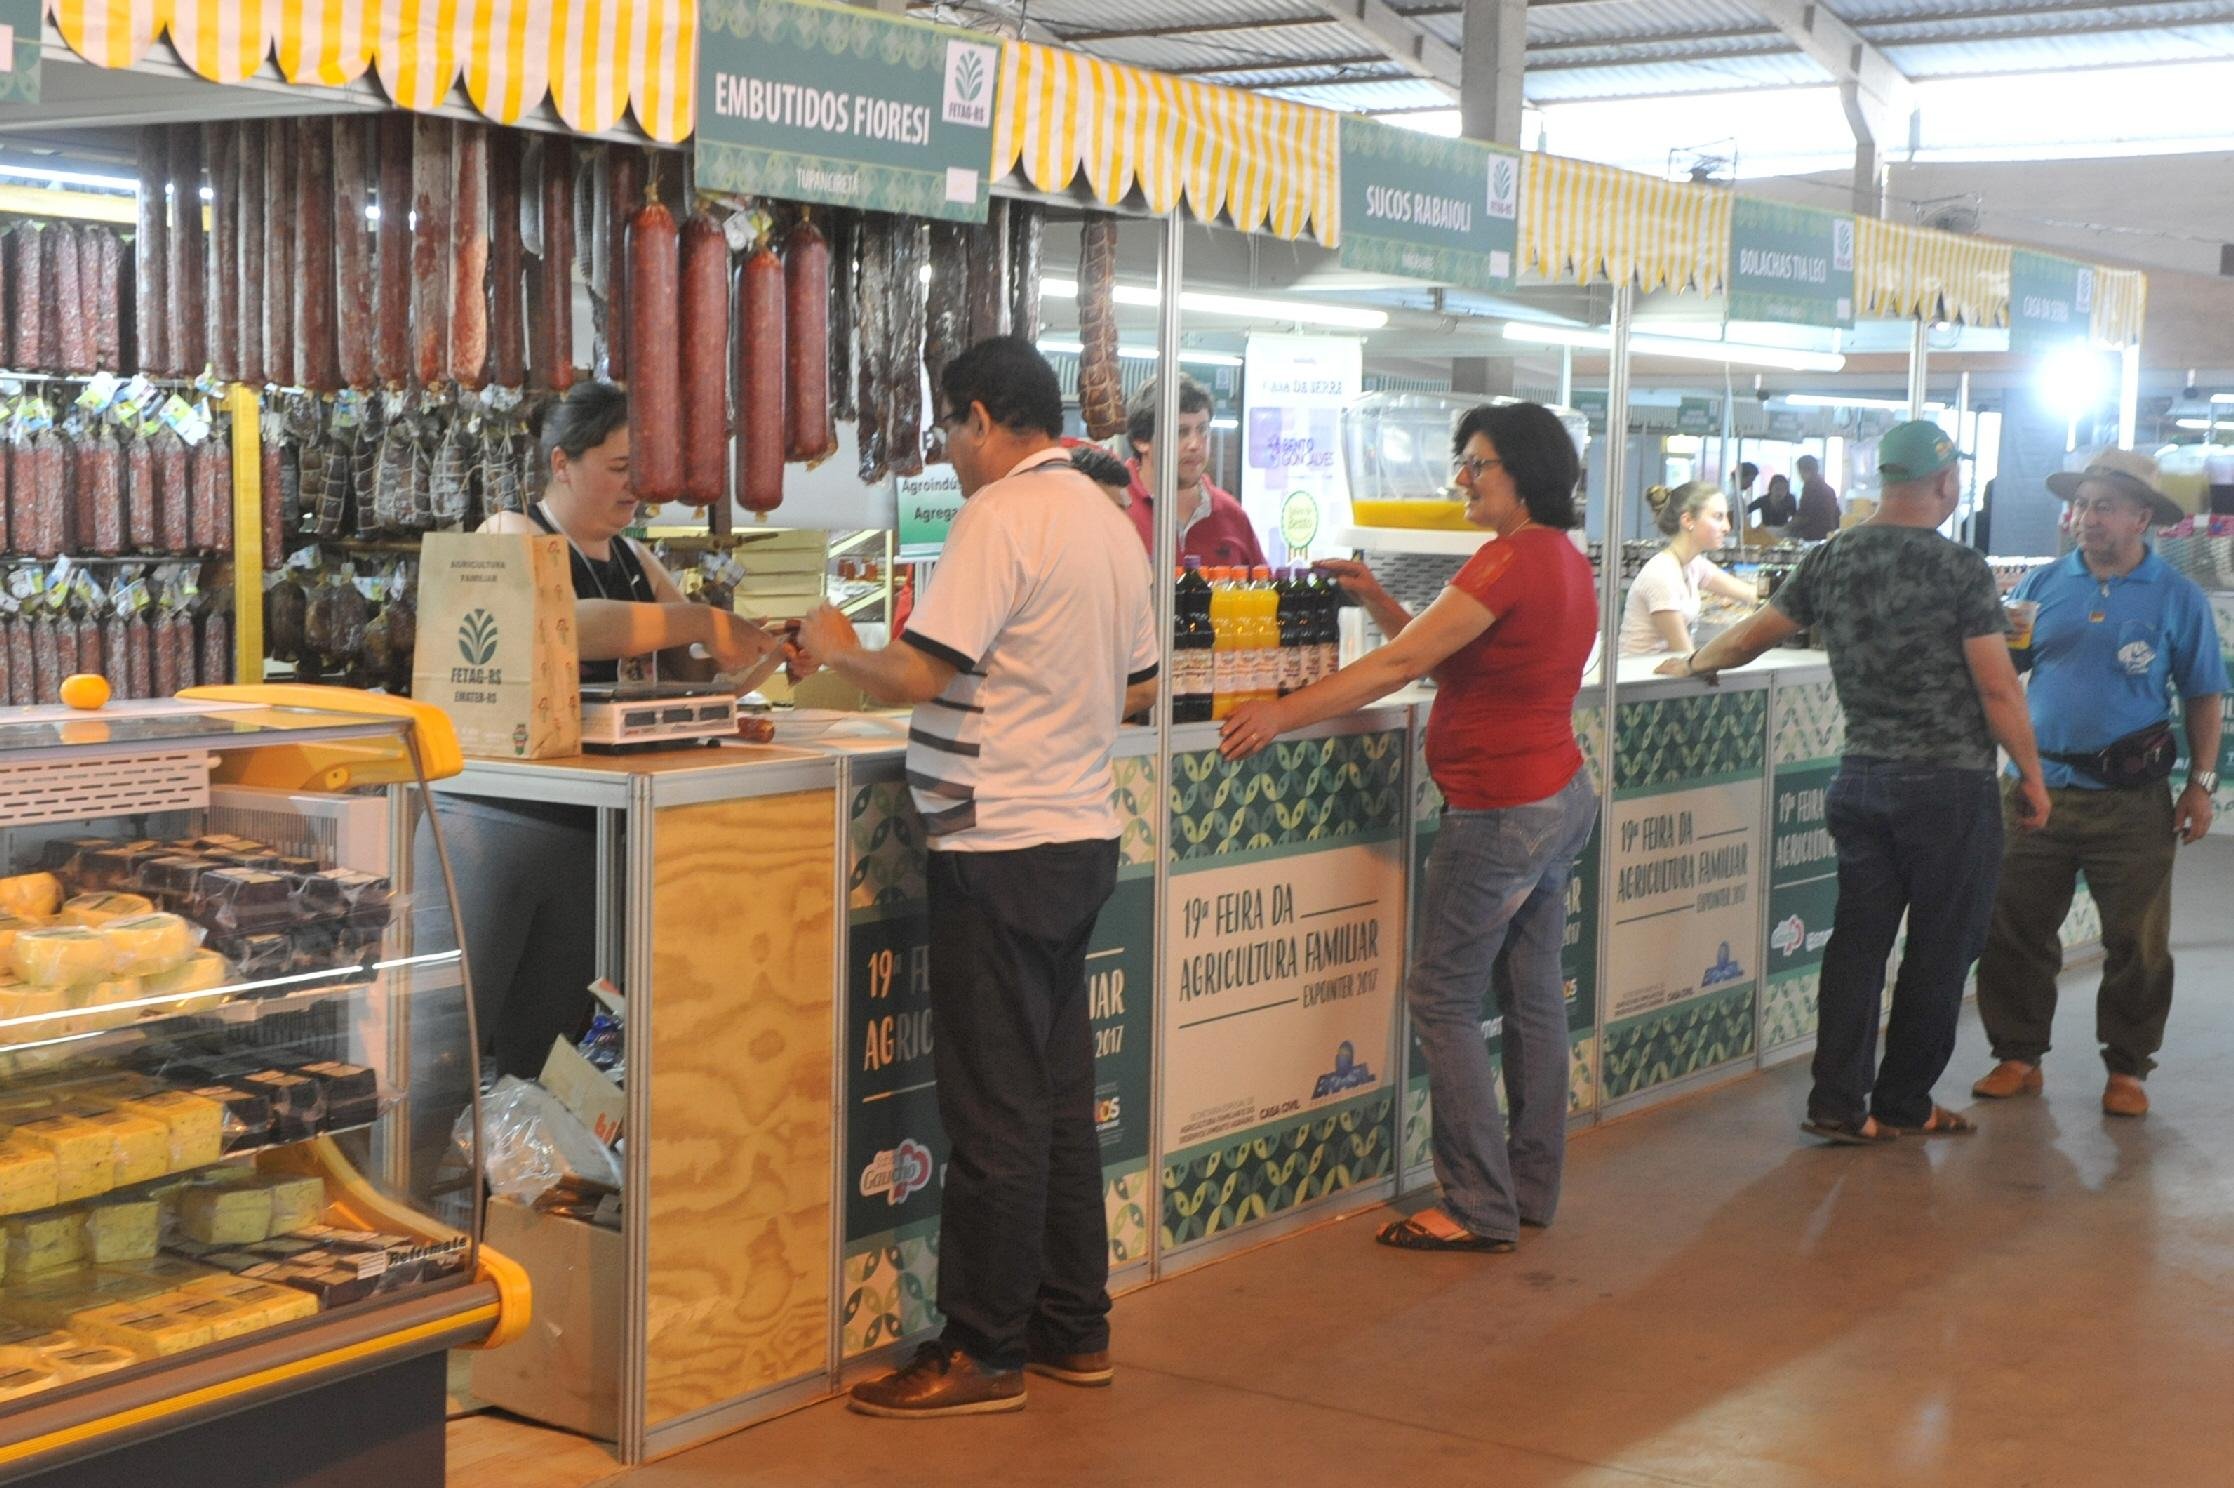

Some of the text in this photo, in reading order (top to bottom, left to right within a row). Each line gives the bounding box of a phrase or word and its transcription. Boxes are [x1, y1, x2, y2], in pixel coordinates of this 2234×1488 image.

[715, 72, 931, 146] EMBUTIDOS FIORESI
[1366, 185, 1471, 232] SUCOS RABAIOLI
[1739, 248, 1792, 279] BOLACHAS
[901, 477, 961, 495] Agroindú
[451, 667, 502, 685] FETAG-RS
[1642, 814, 1674, 853] FEIRA
[1679, 811, 1693, 846] DA
[1617, 842, 1748, 904] AGRICULTURA FAMILIAR
[1216, 888, 1264, 937] FEIRA
[1272, 882, 1295, 926] DA
[1179, 918, 1380, 1002] AGRICULTURA FAMILIAR
[1302, 967, 1379, 1009] EXPOINTER 2017
[1095, 1025, 1125, 1059] 2017
